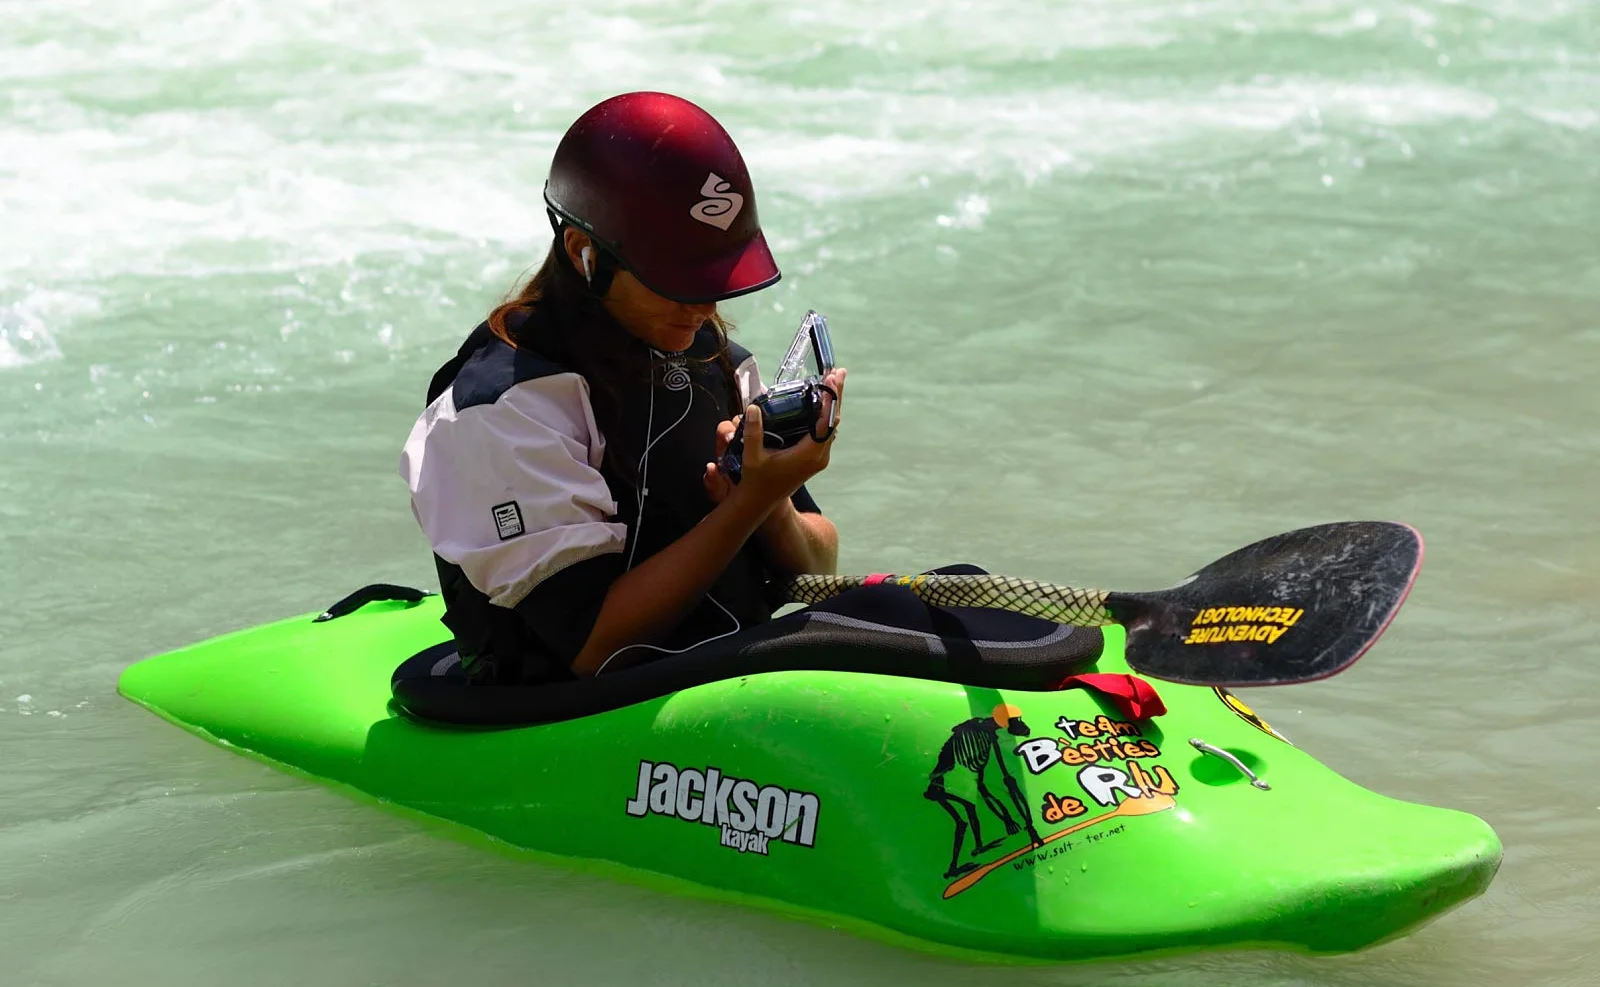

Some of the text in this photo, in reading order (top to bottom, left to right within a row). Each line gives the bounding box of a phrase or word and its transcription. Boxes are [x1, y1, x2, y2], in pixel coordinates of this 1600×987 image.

[1191, 606, 1305, 627] TECHNOLOGY
[1184, 624, 1289, 645] ADVENTURE
[1055, 716, 1142, 740] team
[1041, 792, 1088, 823] de
[719, 822, 769, 855] kayak
